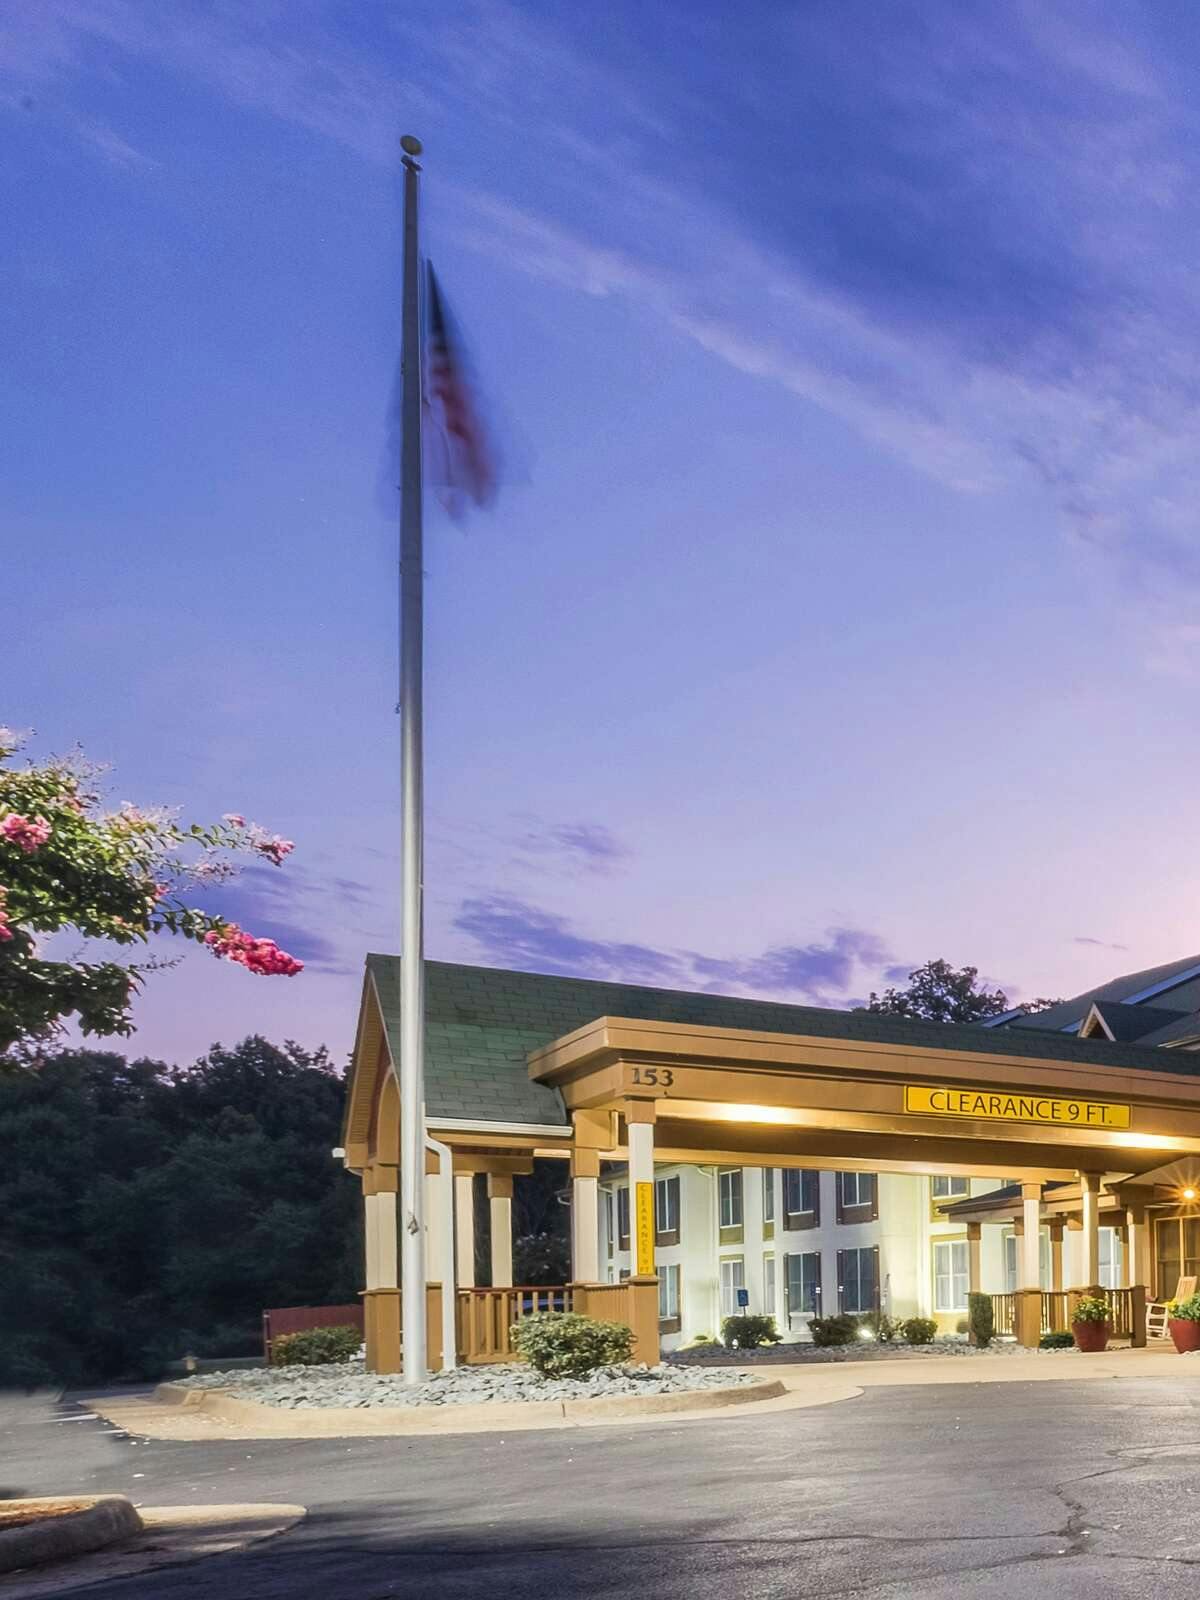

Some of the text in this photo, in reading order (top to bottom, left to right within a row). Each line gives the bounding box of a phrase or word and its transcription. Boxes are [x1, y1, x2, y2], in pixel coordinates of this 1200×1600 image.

[631, 1067, 674, 1087] 153
[929, 1091, 1113, 1124] CLEARANCE 9 FT.
